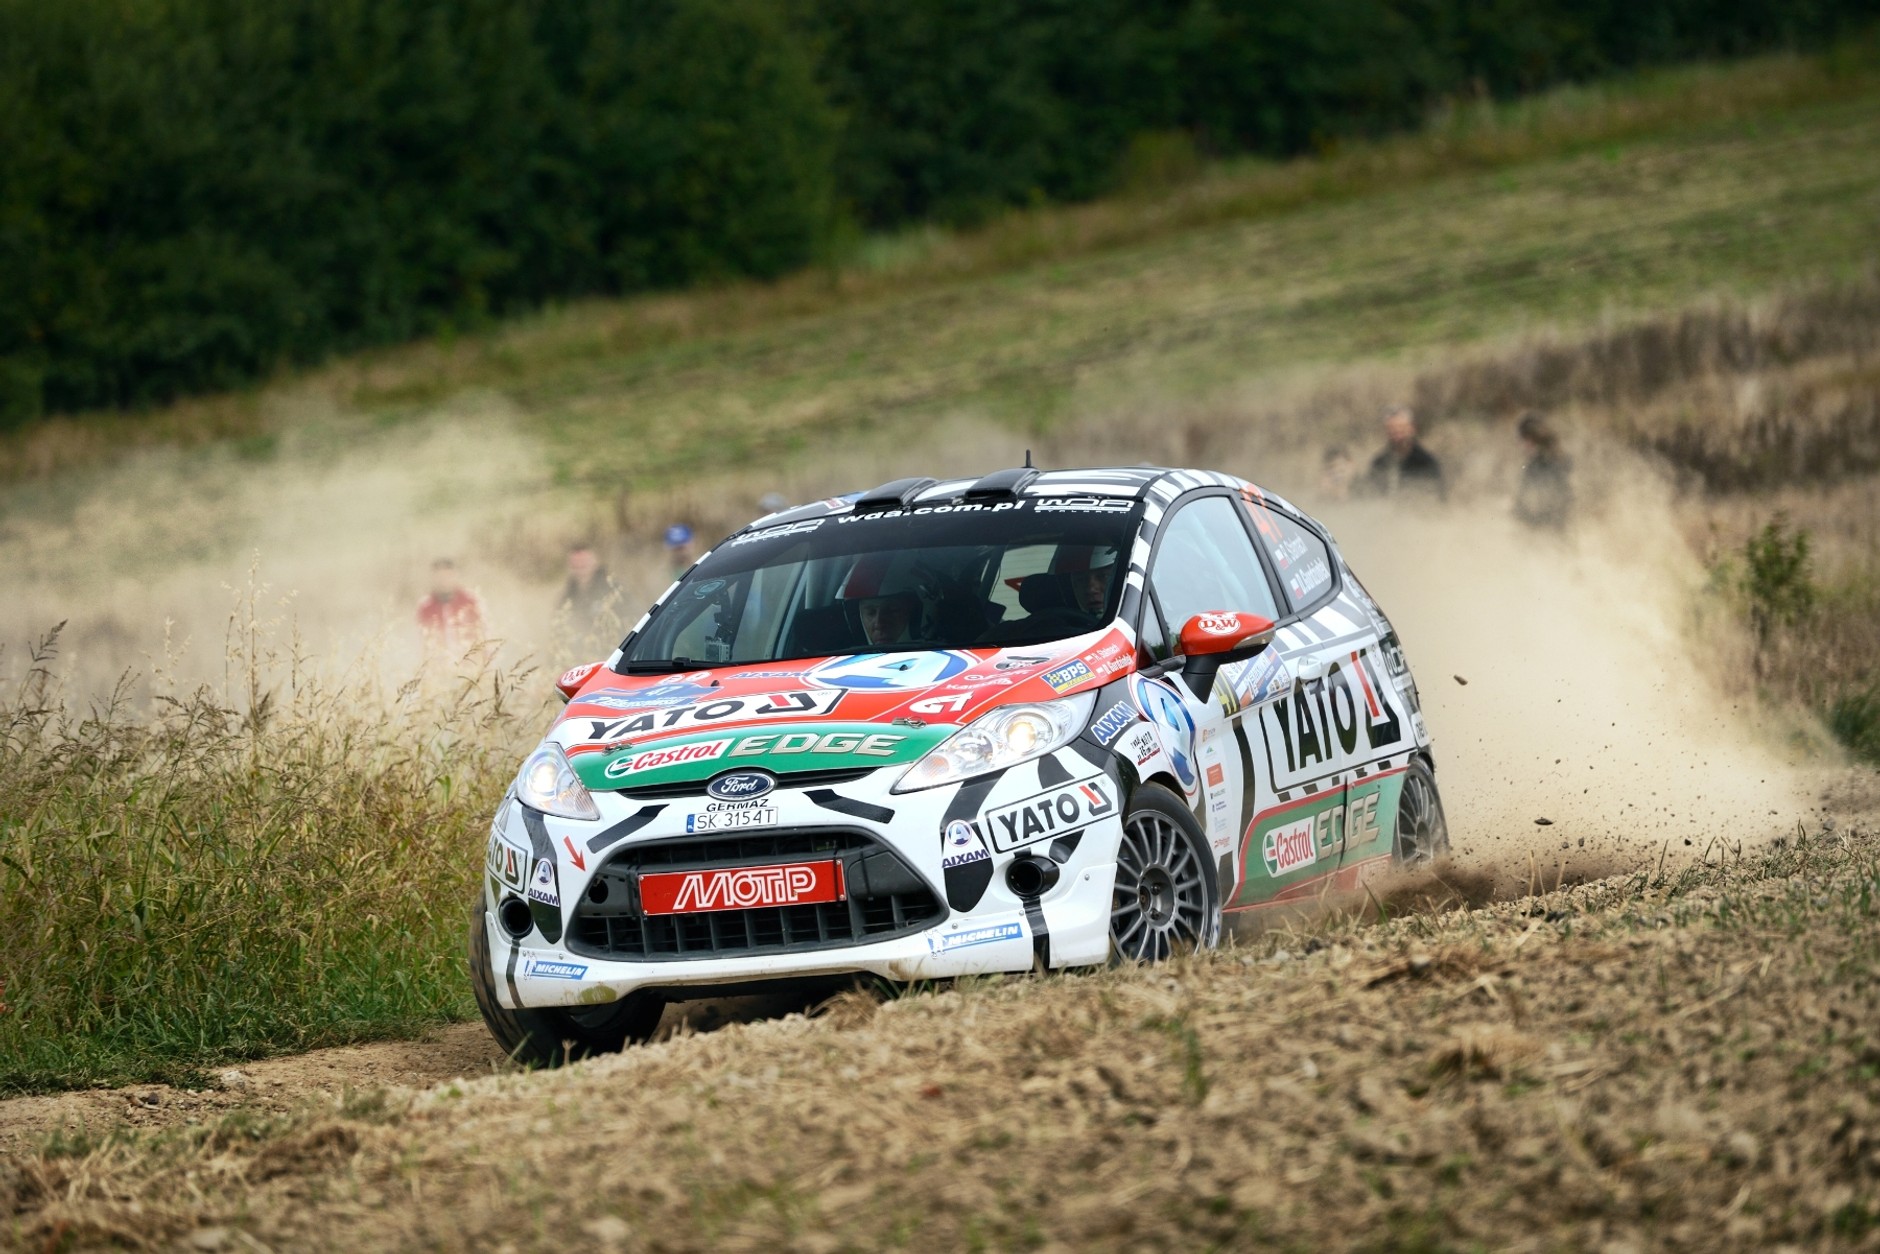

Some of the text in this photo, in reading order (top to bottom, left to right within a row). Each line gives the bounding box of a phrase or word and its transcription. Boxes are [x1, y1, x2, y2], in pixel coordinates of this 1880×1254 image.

[838, 500, 1027, 524] wda.com.pl
[1037, 498, 1135, 508] WDA
[1200, 619, 1237, 631] D&W
[1058, 662, 1087, 682] BPS
[588, 701, 745, 740] YATO
[1092, 702, 1137, 742] AIXAM
[1273, 661, 1357, 773] YATO
[633, 733, 908, 770] Castrol EDGE
[721, 776, 759, 793] Ford
[706, 799, 769, 812] GERMAZ
[697, 809, 774, 829] SK 3154T
[998, 793, 1080, 843] YATO
[1276, 792, 1380, 869] Castrol EDGE
[941, 848, 989, 869] AIXAM
[528, 888, 559, 906] AIXAM
[947, 925, 1019, 946] MICHELIN
[535, 964, 584, 976] MICHELIN
